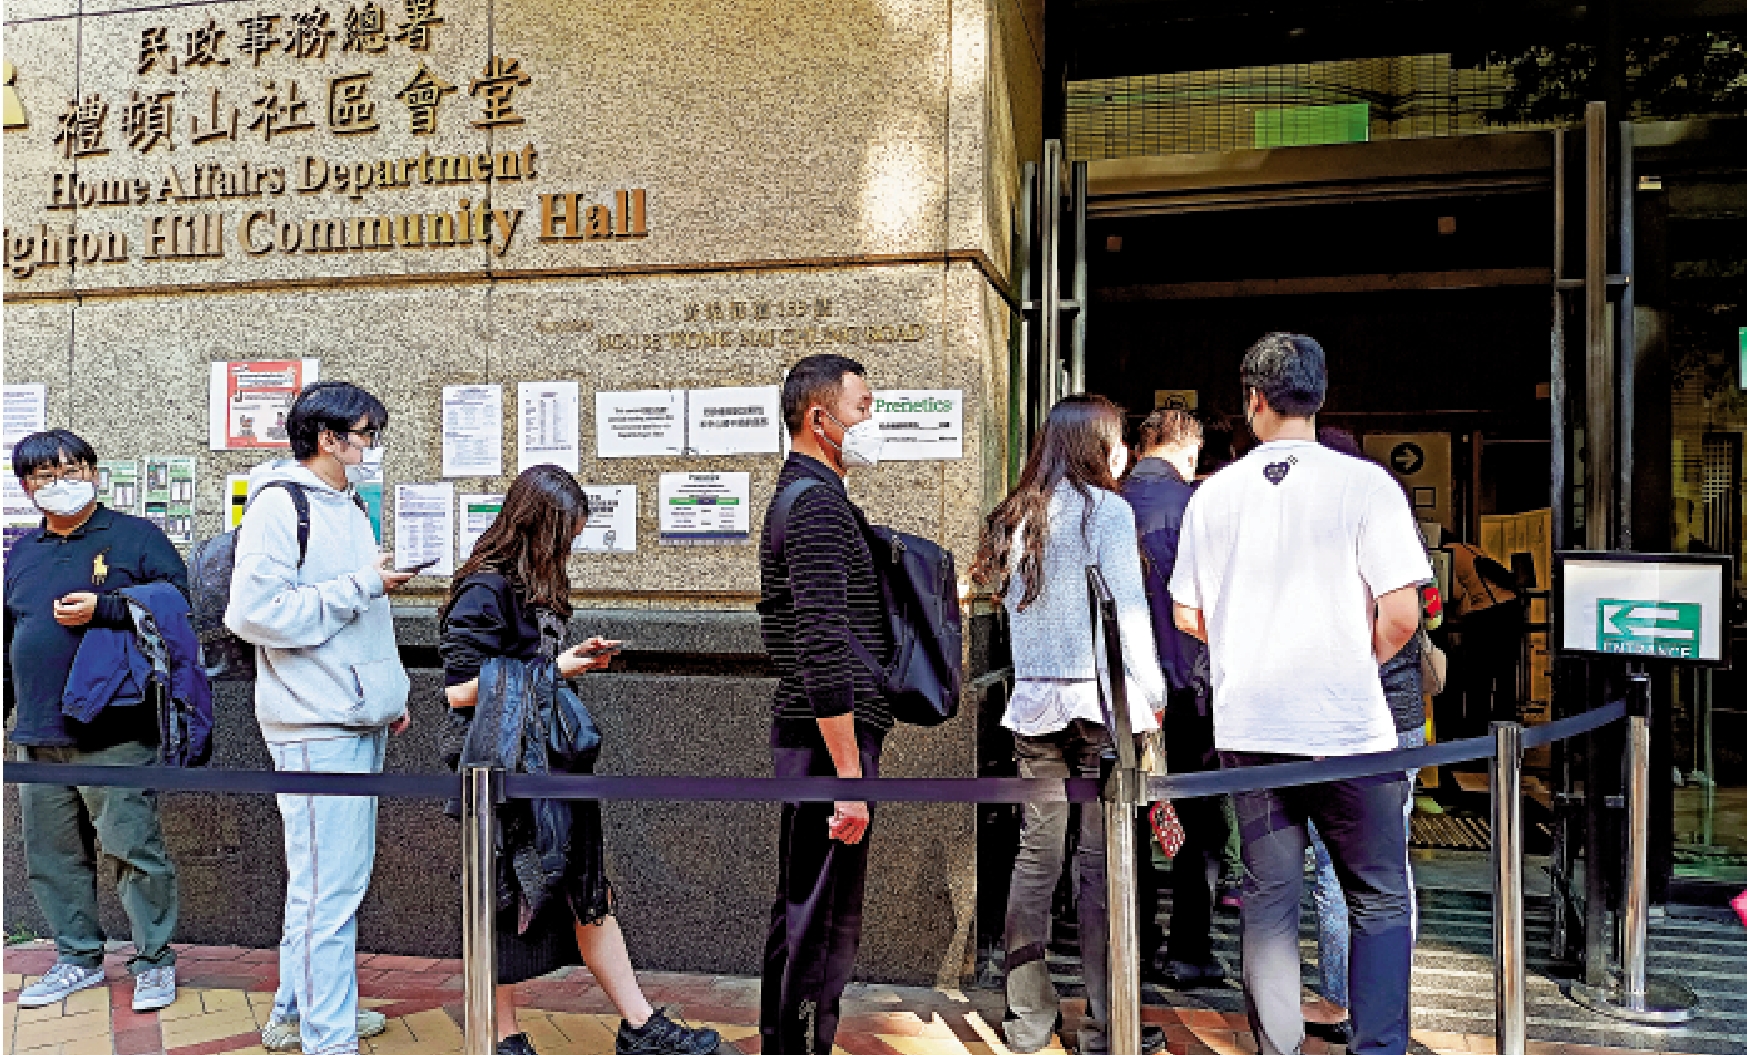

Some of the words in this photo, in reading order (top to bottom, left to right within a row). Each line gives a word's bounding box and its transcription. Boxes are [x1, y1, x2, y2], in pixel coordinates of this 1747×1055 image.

[137, 0, 445, 76] 民政事務總署
[52, 56, 532, 160] 禮頓山社區會堂
[46, 173, 150, 210] Home
[157, 162, 287, 204] Affairs
[297, 146, 538, 200] Department
[142, 212, 225, 260] Hill
[238, 200, 523, 257] Community
[538, 188, 648, 241] Hall
[873, 396, 953, 413] Prenetics
